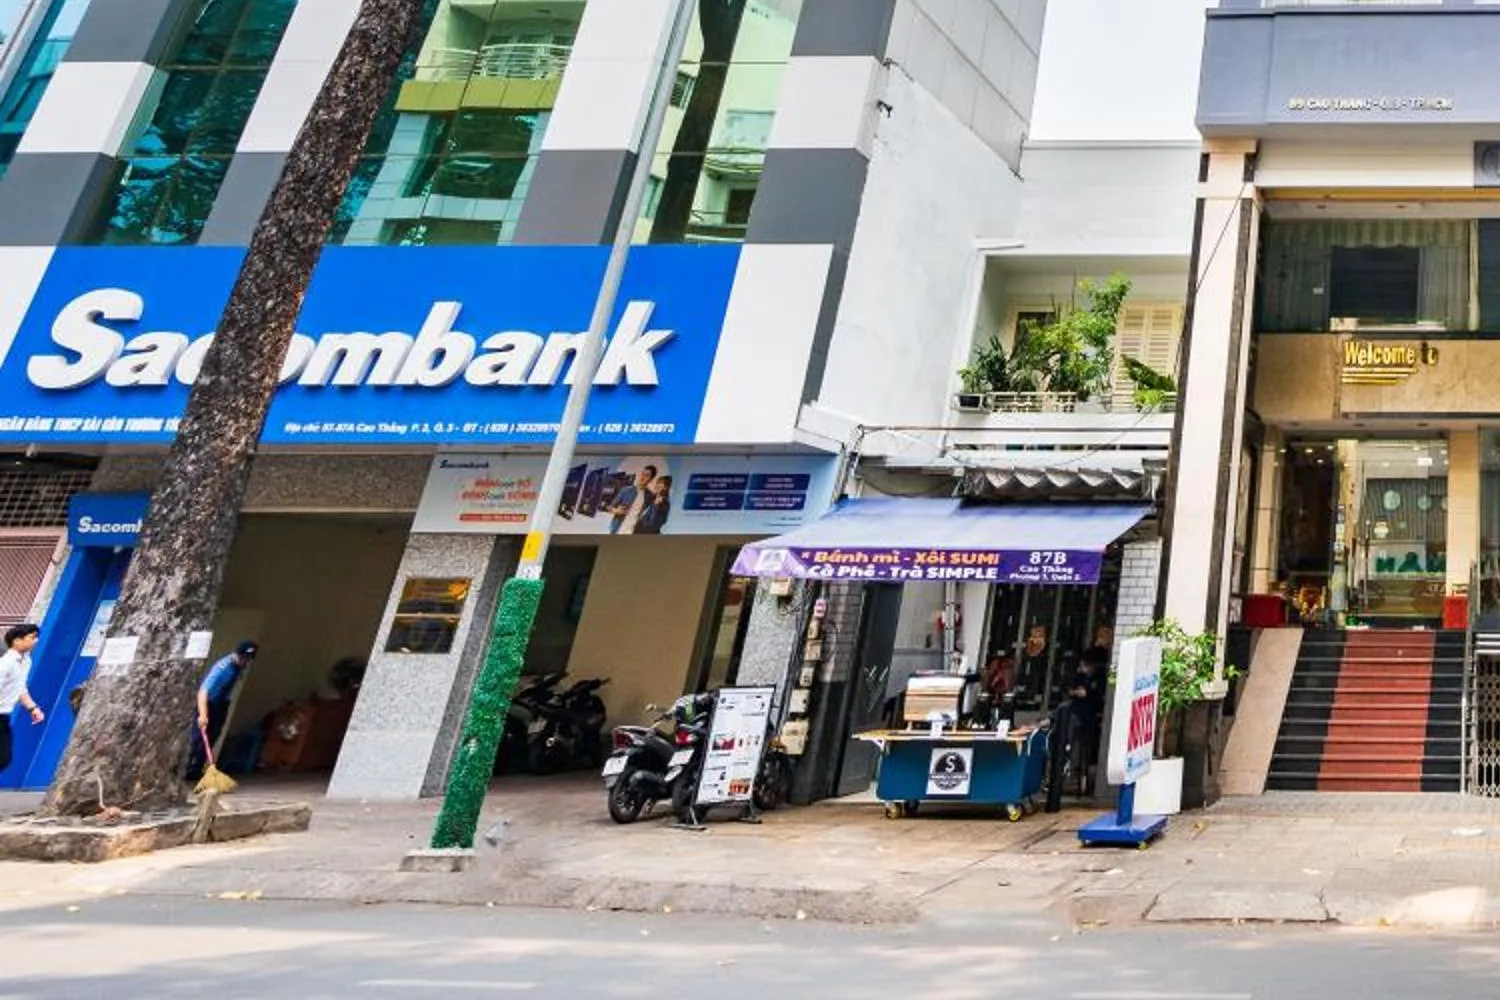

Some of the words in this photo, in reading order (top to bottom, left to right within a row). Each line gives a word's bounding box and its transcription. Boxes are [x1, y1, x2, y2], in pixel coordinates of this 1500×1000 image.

[1344, 340, 1416, 366] Welcome
[814, 549, 870, 563] Bánh
[1029, 551, 1067, 565] 87B
[807, 564, 834, 578] Cà
[836, 564, 875, 578] Phê
[889, 566, 924, 579] Trà
[926, 567, 999, 579] SIMPLE
